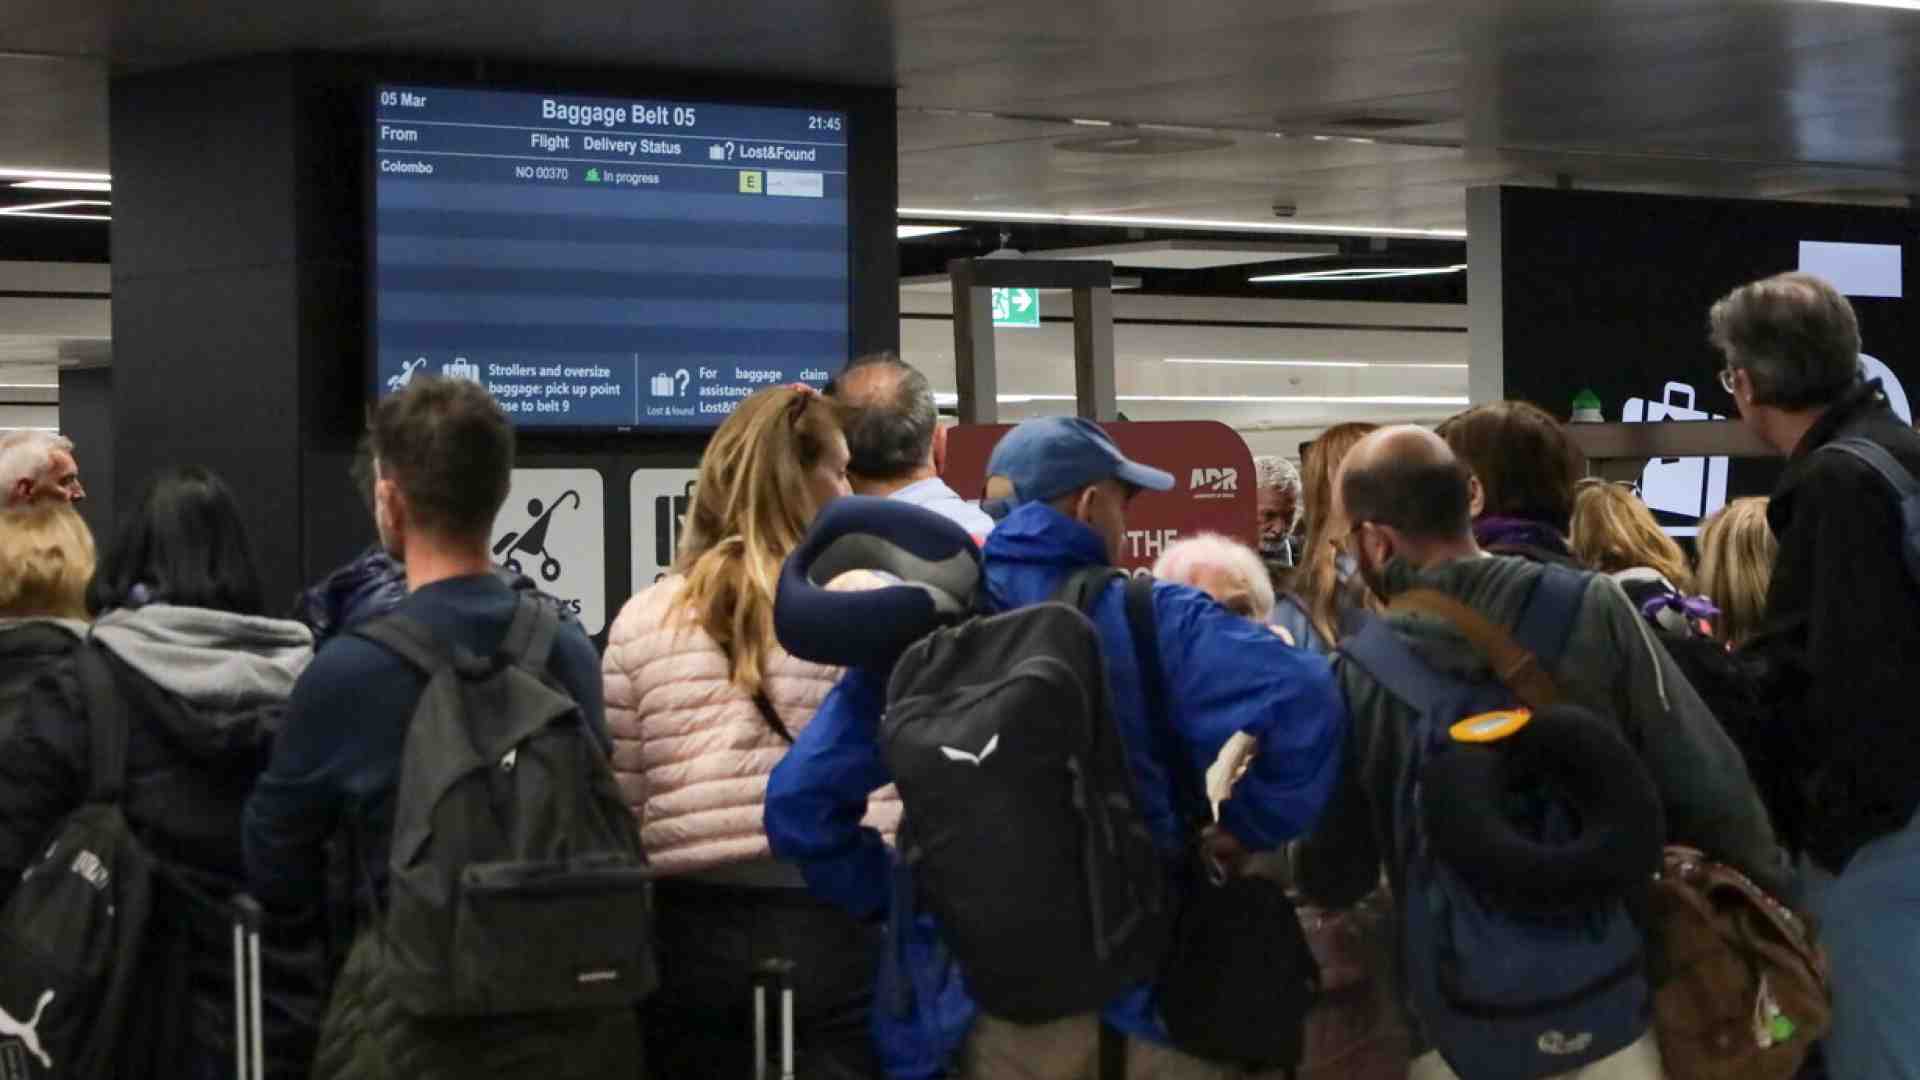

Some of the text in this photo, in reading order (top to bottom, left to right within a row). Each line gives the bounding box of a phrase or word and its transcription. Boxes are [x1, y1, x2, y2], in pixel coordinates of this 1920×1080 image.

[381, 91, 427, 107] 05 Mar
[542, 99, 696, 127] Baggage Belt 05
[808, 116, 841, 131] 21:45
[381, 125, 418, 141] From
[531, 133, 569, 151] Flight
[584, 136, 682, 156] Delivery Status
[740, 144, 816, 162] Lost&Found
[381, 159, 433, 174] Colombo
[515, 166, 533, 178] NO
[604, 170, 660, 186] In progress
[488, 363, 611, 378] Strollers and oversize
[699, 367, 829, 382] For baggage claim
[488, 381, 620, 398] baggage: pick up point
[521, 400, 533, 412] to
[537, 400, 560, 412] belt
[562, 400, 570, 412] 9
[1190, 468, 1238, 490] ADR
